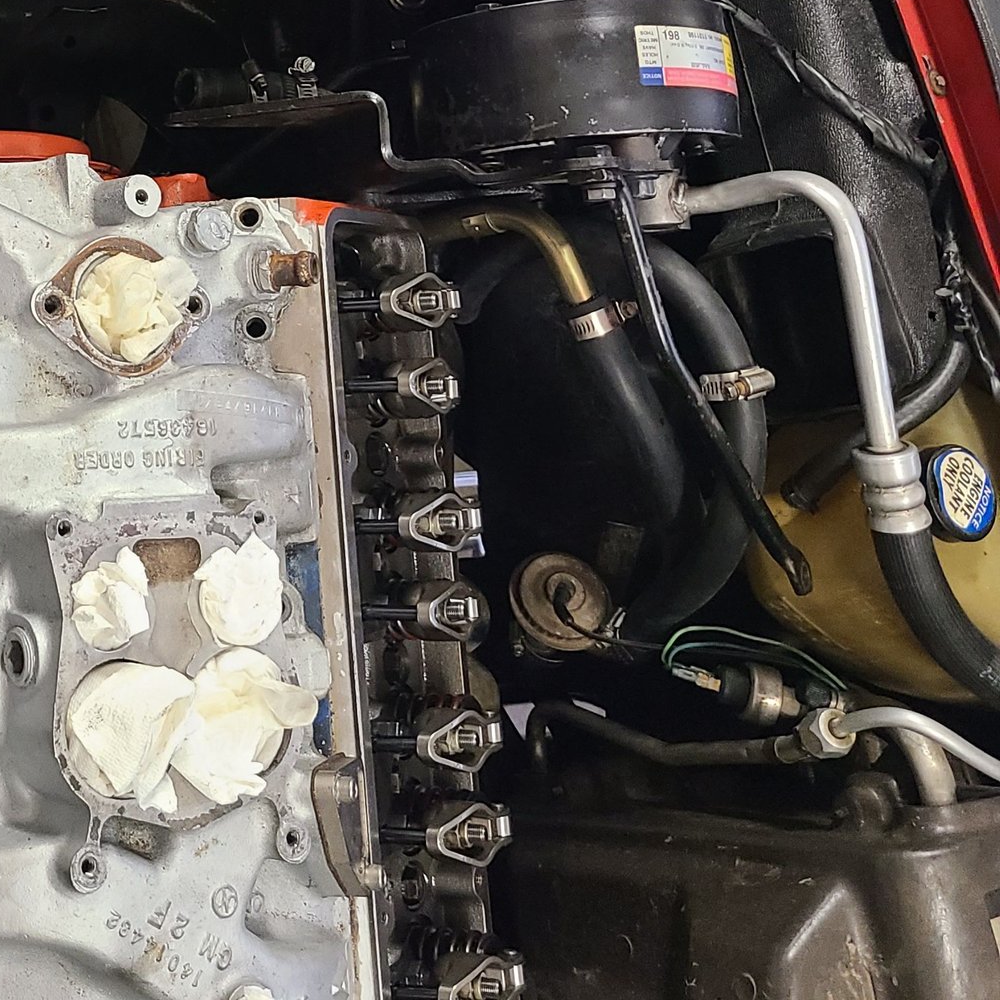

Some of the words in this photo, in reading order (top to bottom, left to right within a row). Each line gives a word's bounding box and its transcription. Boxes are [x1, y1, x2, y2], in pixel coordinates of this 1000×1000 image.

[73, 449, 135, 471] ORDER
[142, 448, 206, 469] FIRING
[943, 457, 960, 491] ONLY
[949, 457, 975, 514] COOLANT
[960, 473, 984, 520] ENGINE
[972, 485, 992, 530] NOTICE
[198, 932, 233, 971] GM
